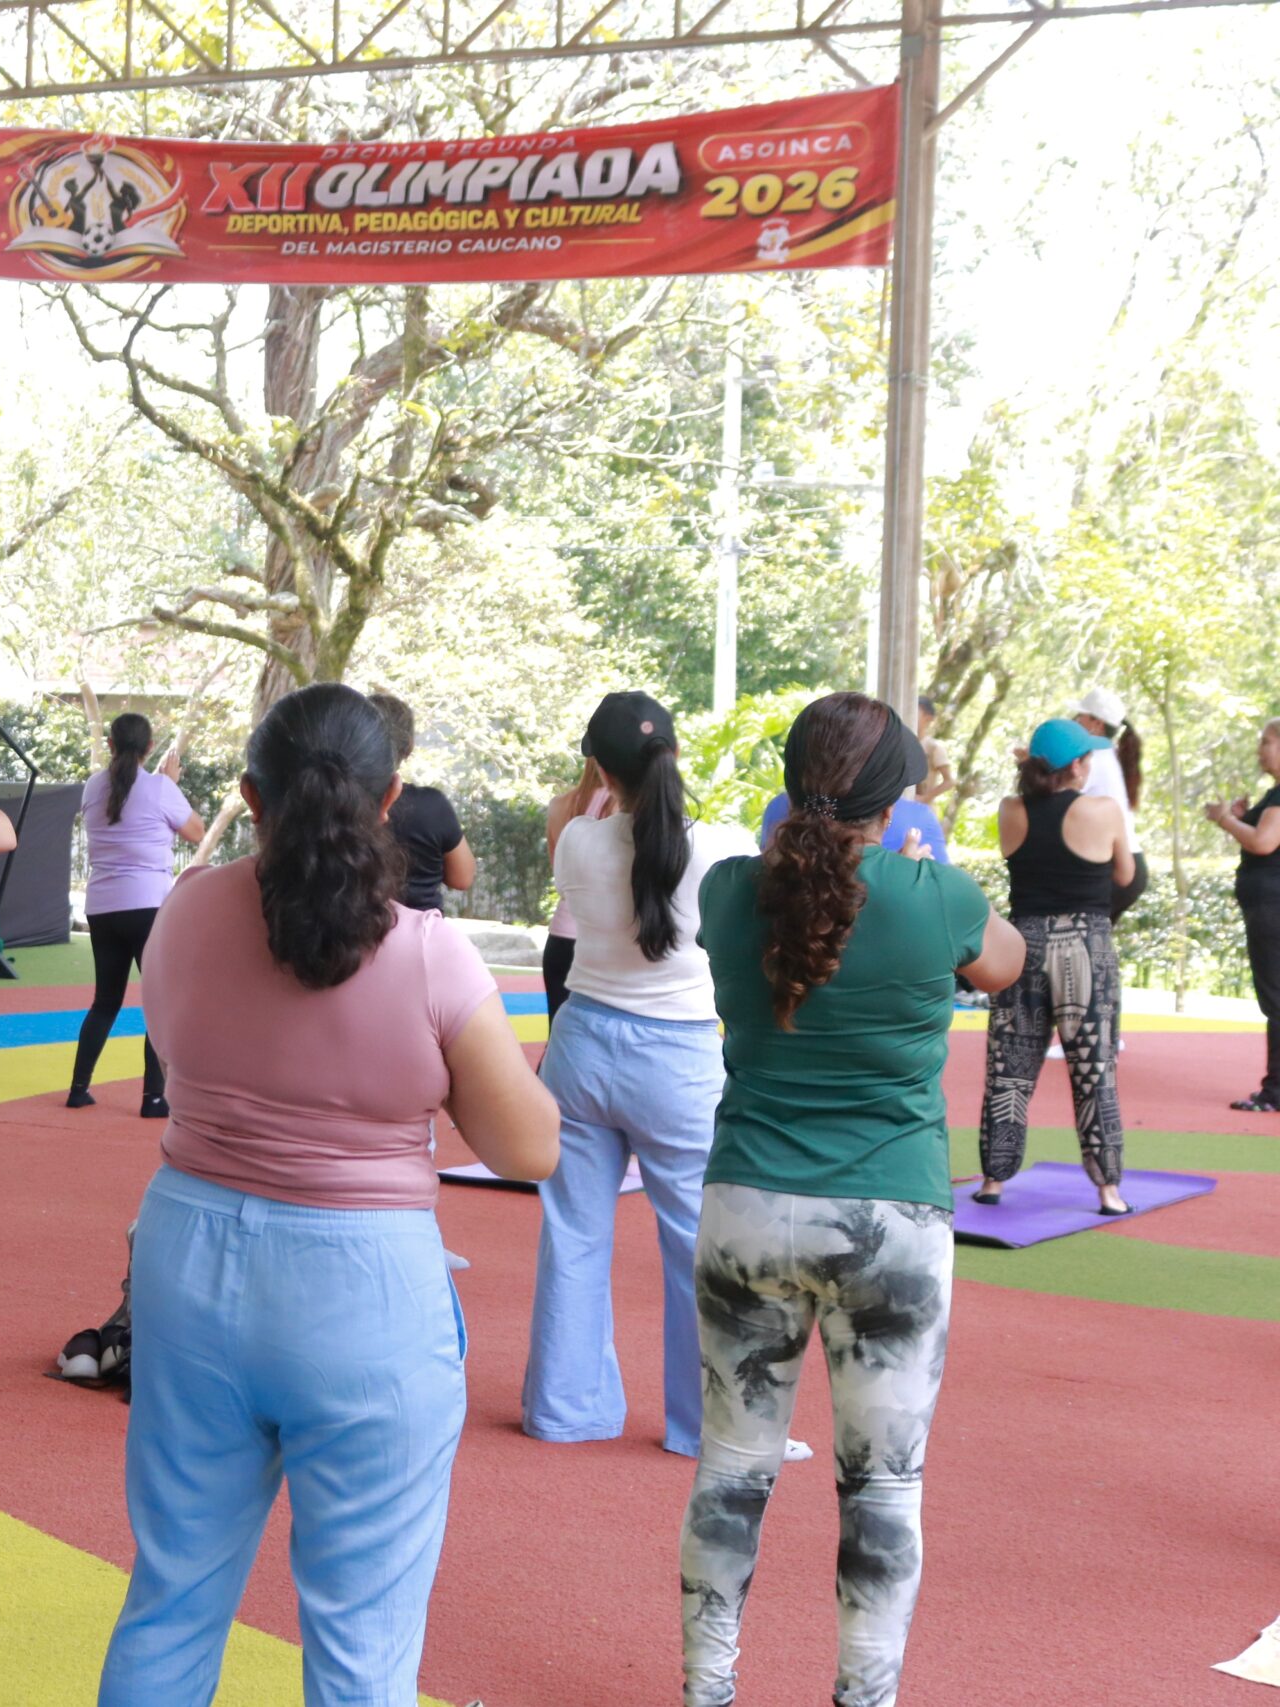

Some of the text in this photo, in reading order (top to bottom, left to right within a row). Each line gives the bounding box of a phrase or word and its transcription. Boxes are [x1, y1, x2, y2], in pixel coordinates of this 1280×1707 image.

[441, 136, 576, 157] SEGUNDA
[717, 134, 853, 163] ASOINCA
[200, 141, 681, 213] XII OLIMPIADA
[700, 166, 860, 218] 2026
[226, 203, 642, 236] DEPORTIVA, PEDAGÓGICA Y CULTURAL
[281, 235, 562, 256] DEL MAGISTERIO CAUCANO
